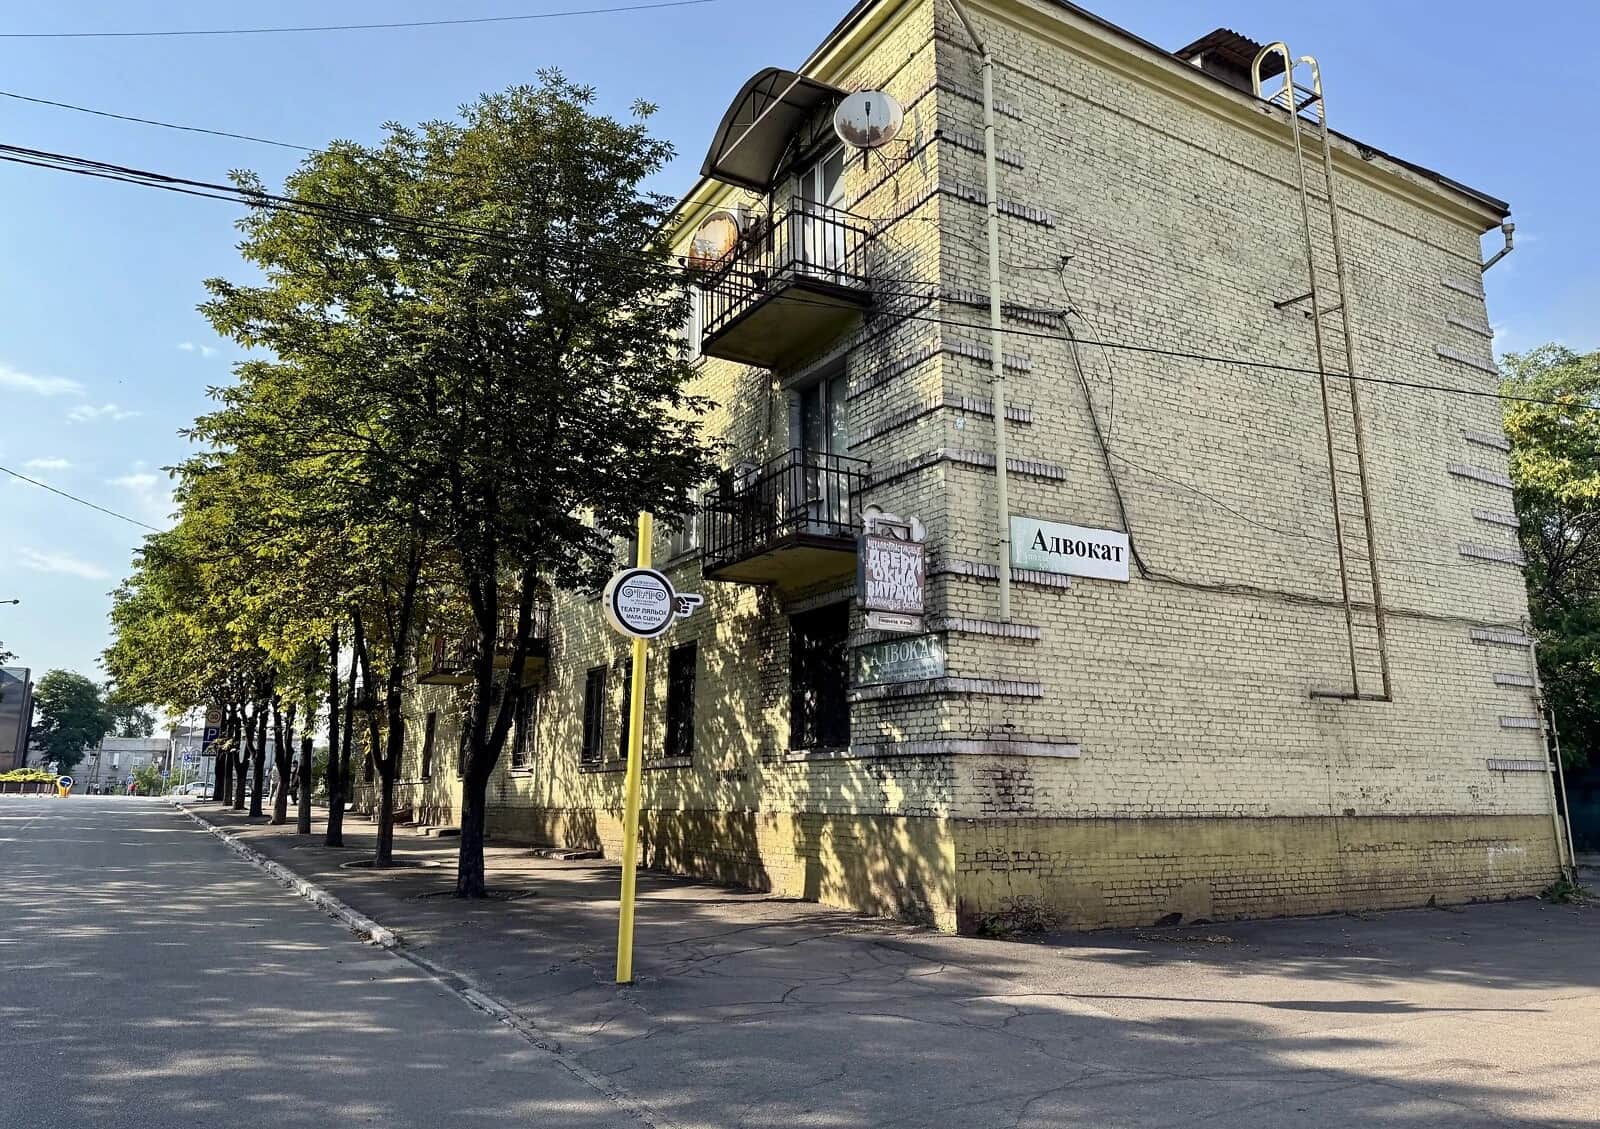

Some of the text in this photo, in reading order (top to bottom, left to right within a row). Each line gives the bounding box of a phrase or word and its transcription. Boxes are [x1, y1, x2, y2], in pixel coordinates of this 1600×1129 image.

[1031, 528, 1124, 562] Адвокат
[868, 549, 922, 574] ДВЕРИ
[871, 563, 917, 587] ОКНА
[867, 580, 922, 603] ВИТРАЖИ
[872, 638, 938, 667] АДВОКАТ
